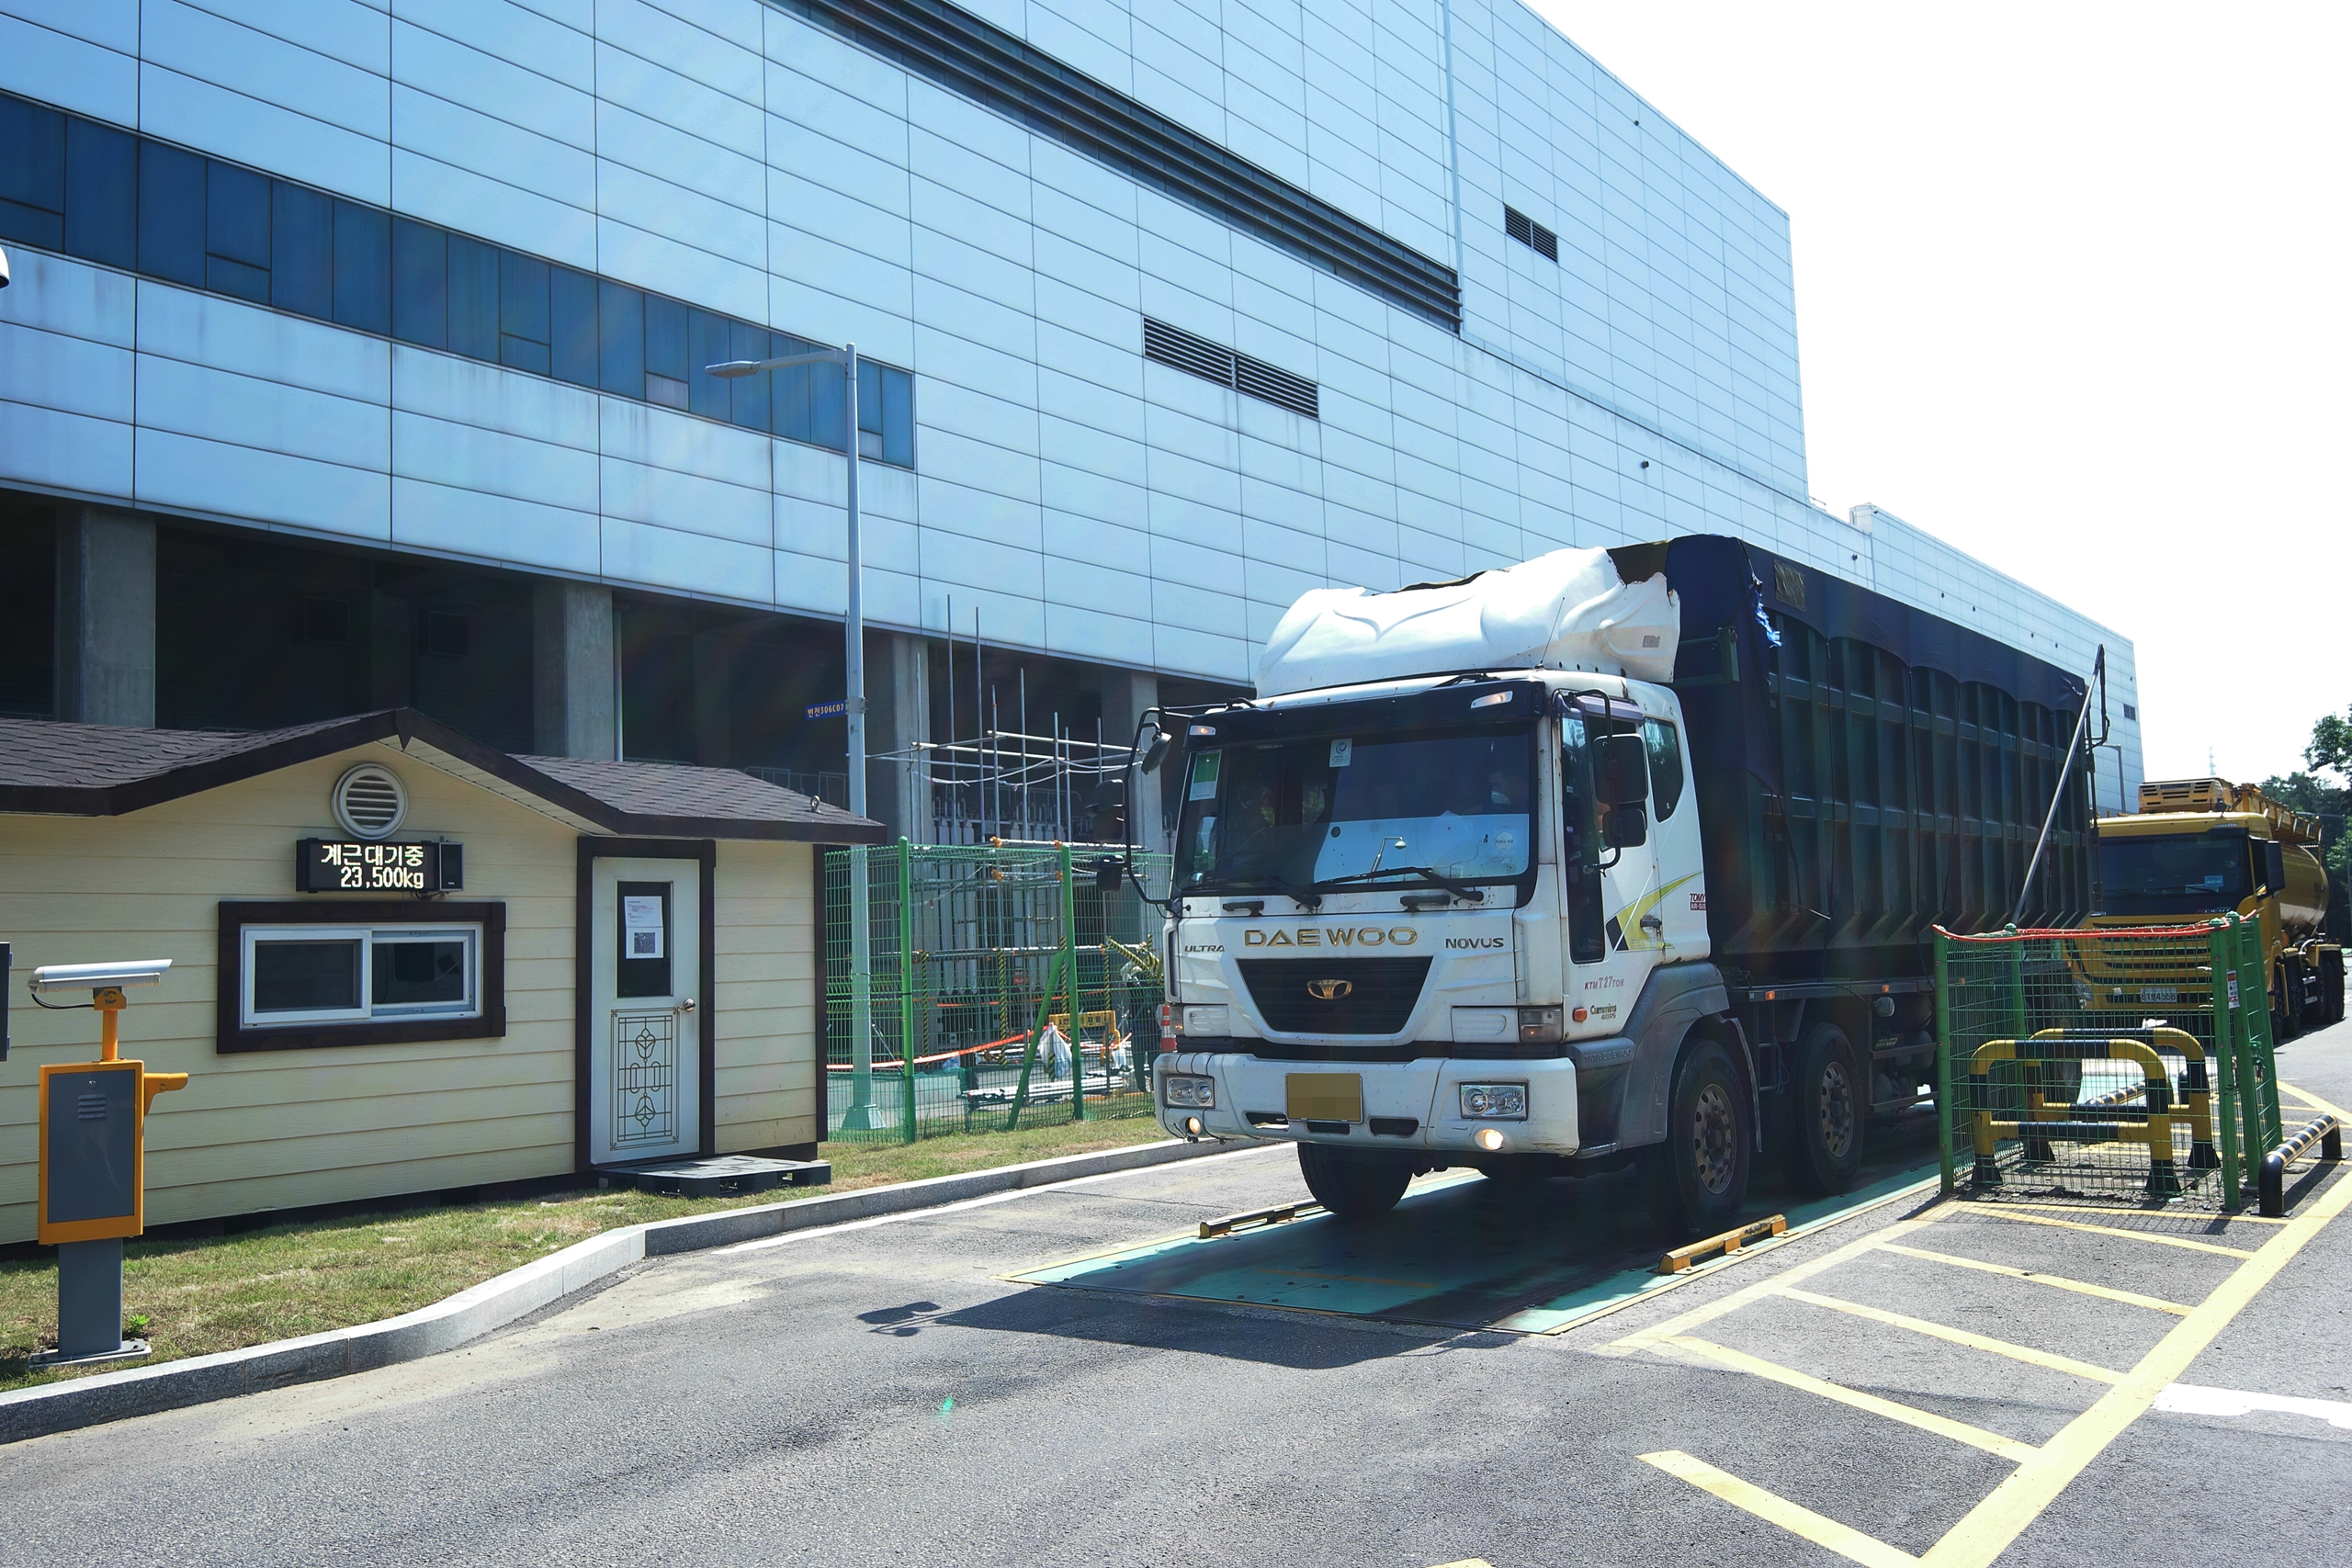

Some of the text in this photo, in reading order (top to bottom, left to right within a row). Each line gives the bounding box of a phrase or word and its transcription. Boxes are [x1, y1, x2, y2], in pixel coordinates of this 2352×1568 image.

[321, 843, 424, 866] 계근대기중
[340, 866, 424, 889] 23,500kg
[1243, 926, 1419, 948] DAEWOO
[1444, 937, 1505, 950] NOVUS
[1183, 944, 1227, 953] ULTRA
[1589, 1002, 1617, 1015] Cummins
